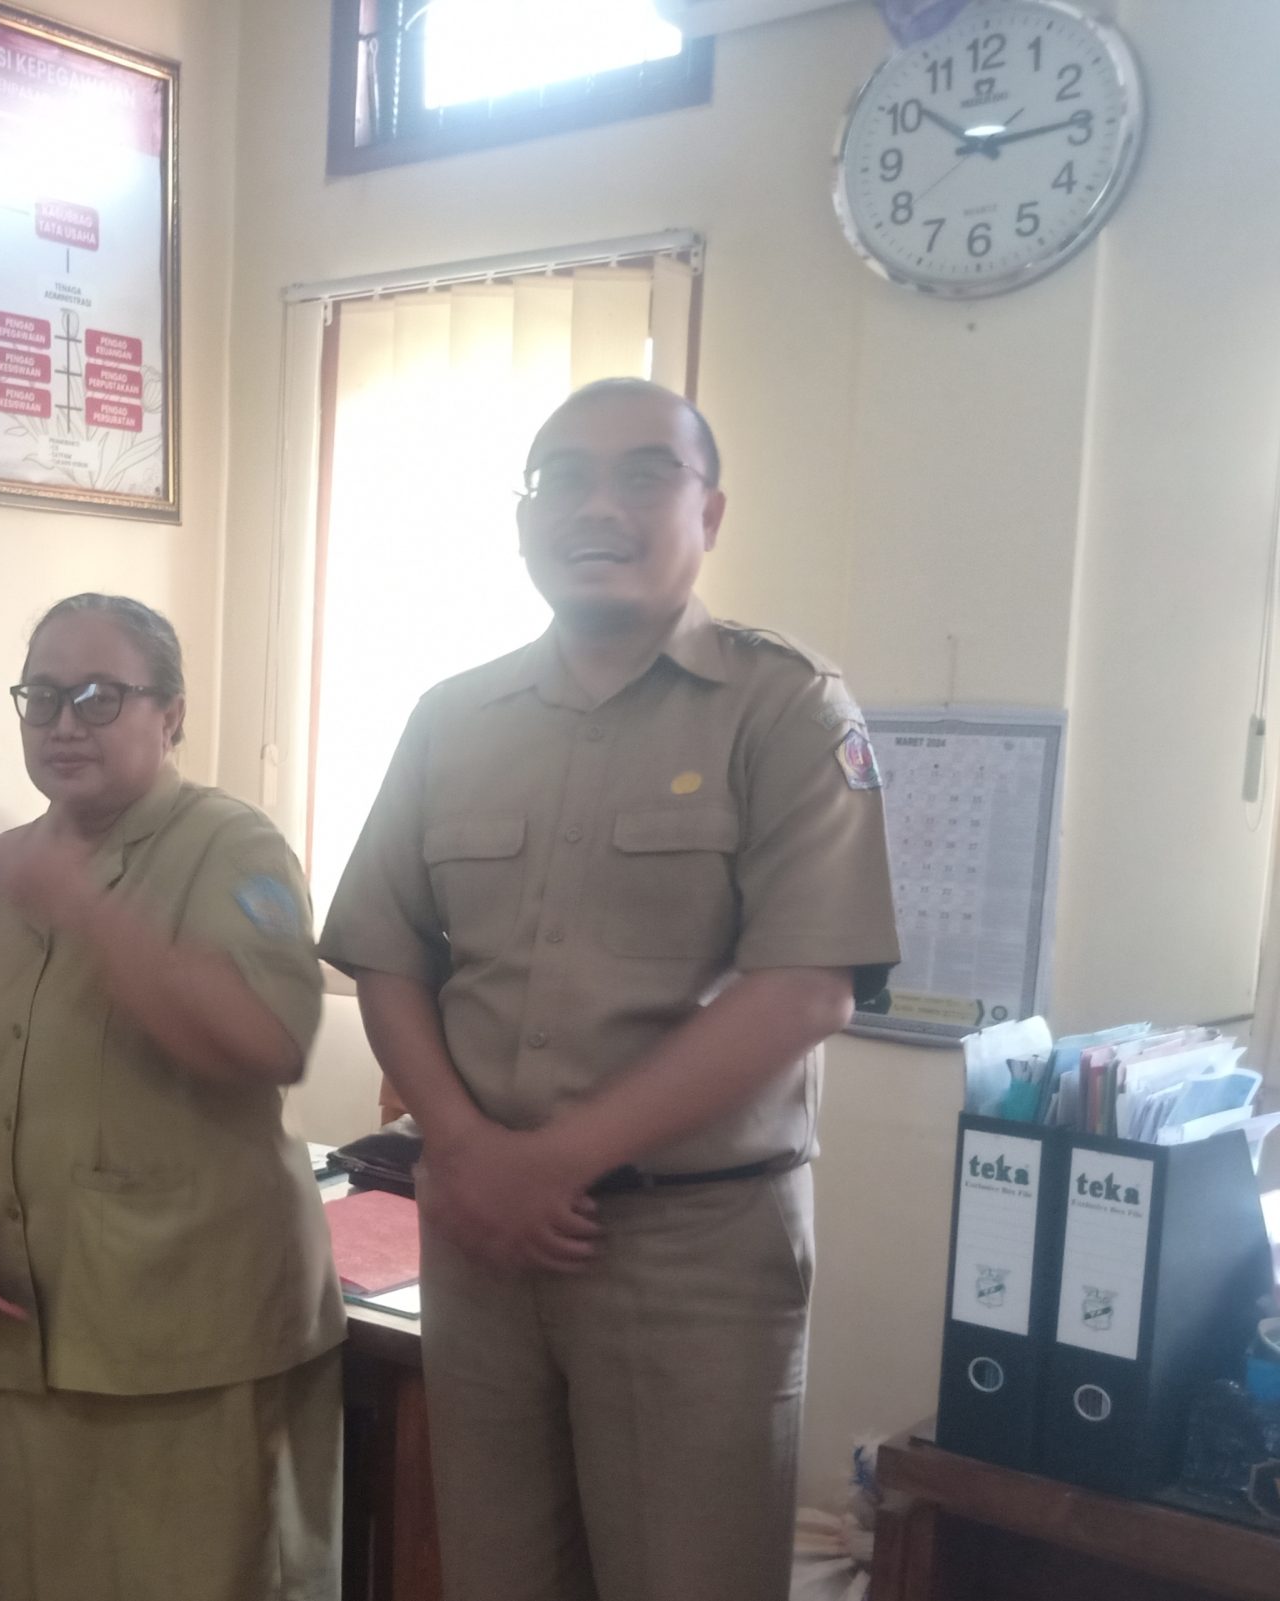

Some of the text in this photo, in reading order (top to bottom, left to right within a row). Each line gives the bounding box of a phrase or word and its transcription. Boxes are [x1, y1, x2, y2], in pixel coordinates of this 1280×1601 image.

[966, 33, 1007, 73] 12
[1027, 35, 1042, 73] 1
[925, 56, 954, 94] 11
[1055, 63, 1083, 102] 2
[886, 98, 923, 136] 10
[1067, 109, 1094, 146] 3
[879, 148, 903, 183] 9
[1051, 160, 1078, 195] 4
[890, 190, 914, 226] 8
[1015, 201, 1041, 237] 5
[39, 219, 97, 245] TATA USAHA
[923, 217, 946, 253] 7
[967, 222, 992, 258] 6
[895, 736, 925, 747] MARET
[969, 1154, 1030, 1186] teka
[1076, 1172, 1141, 1206] teka
